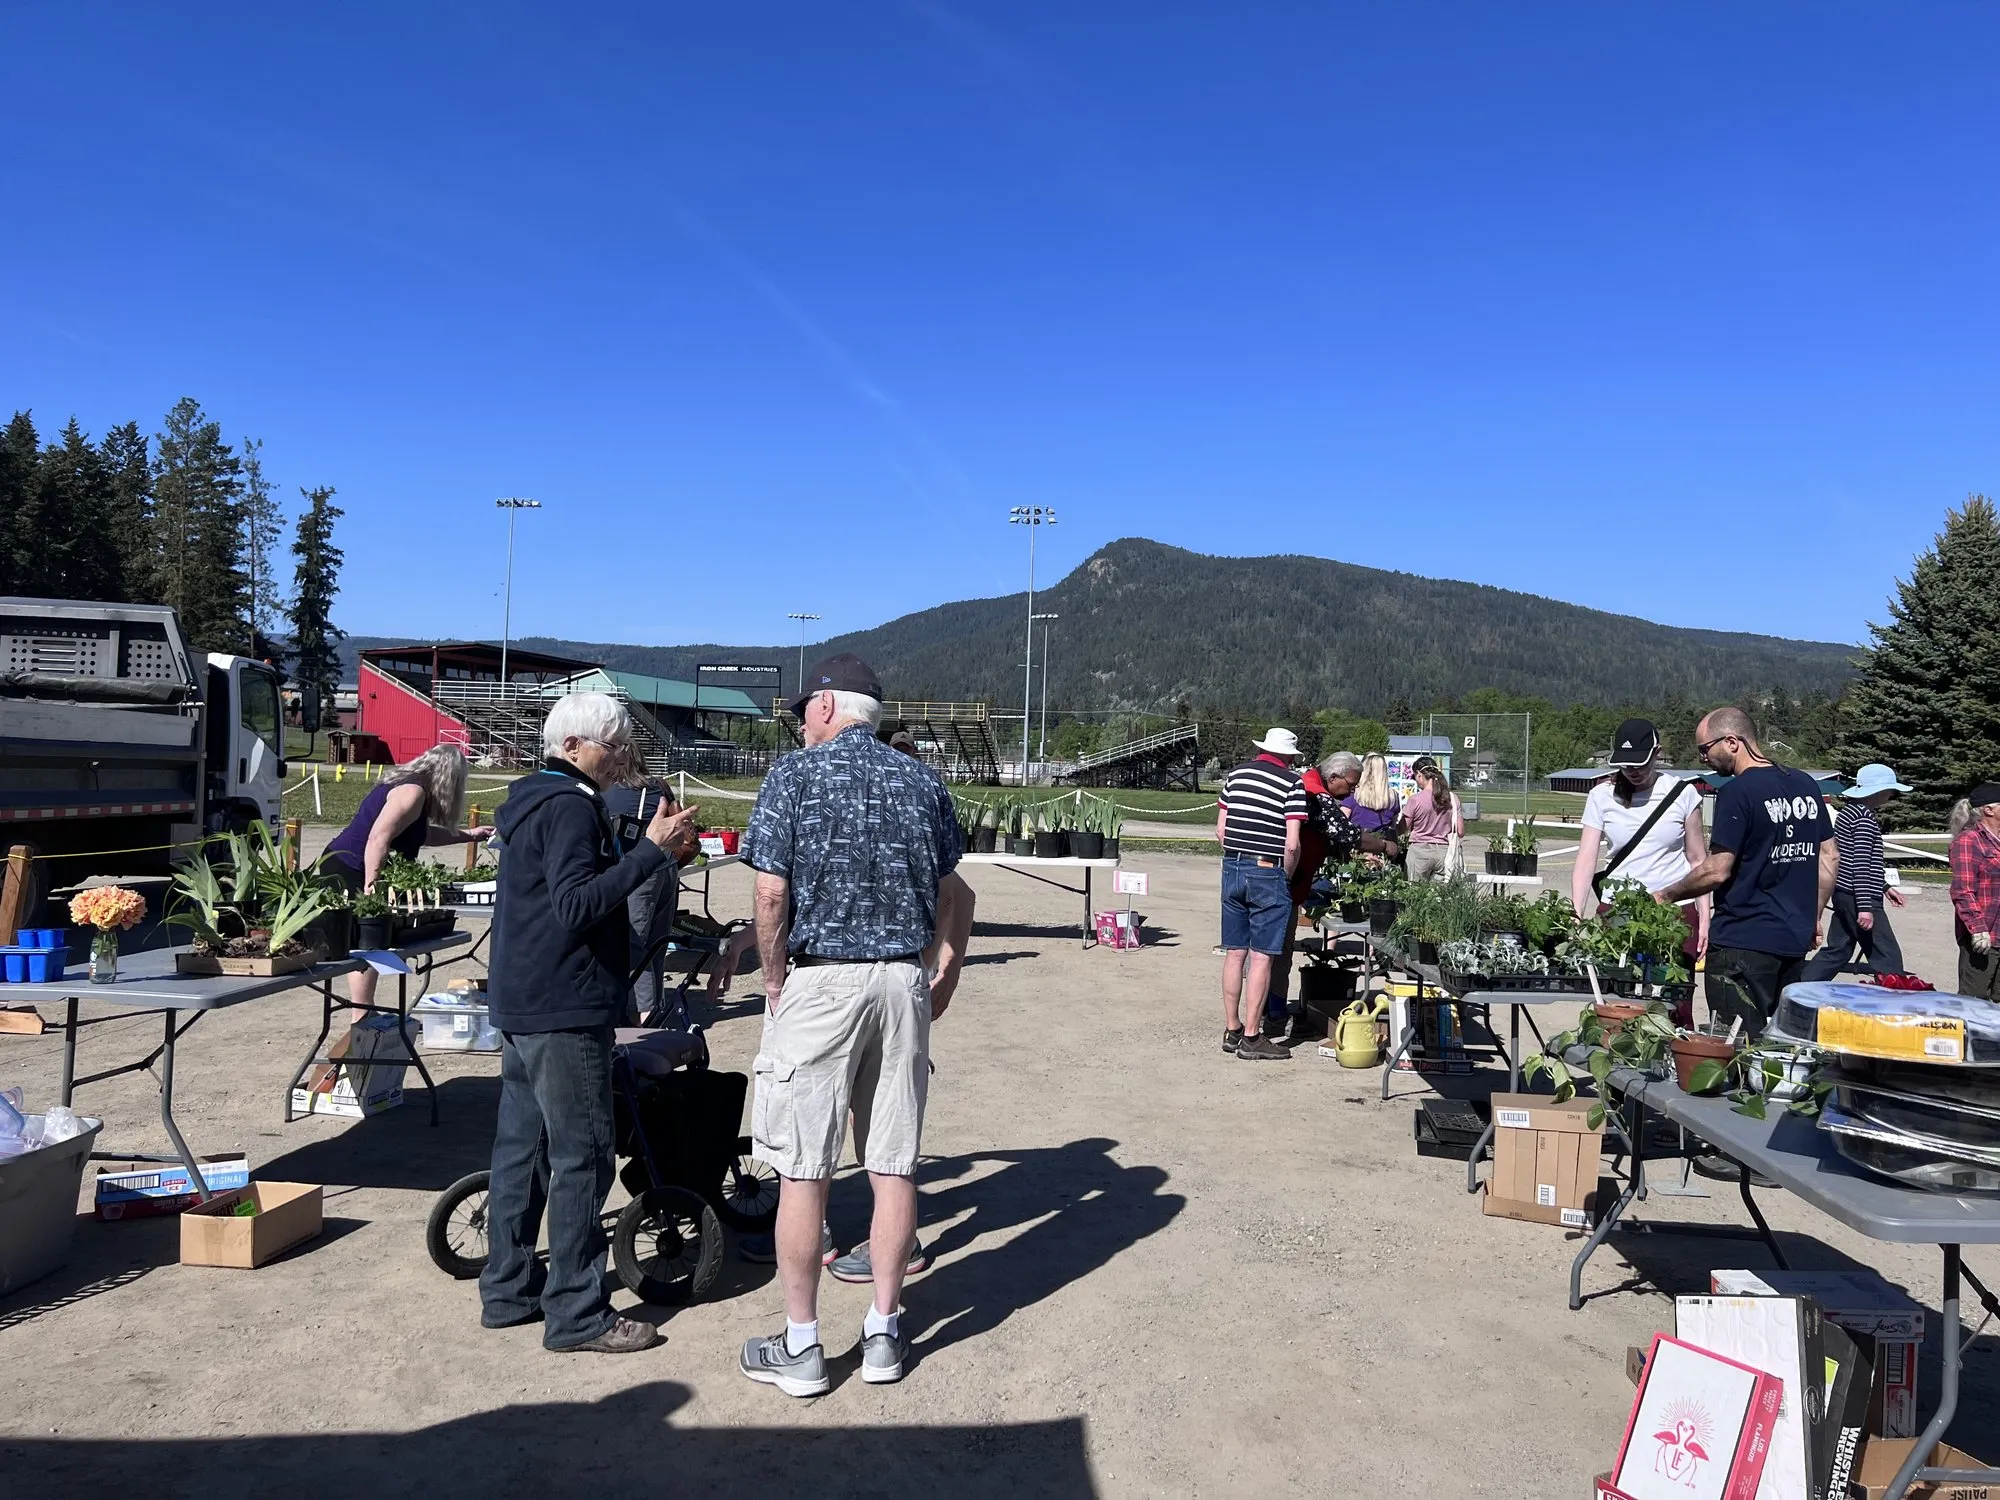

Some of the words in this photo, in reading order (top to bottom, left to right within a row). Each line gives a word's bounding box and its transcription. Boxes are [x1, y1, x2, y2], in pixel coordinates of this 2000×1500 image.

[1466, 738, 1473, 746] 2
[1747, 1422, 1763, 1463] FLAMINGOS
[1757, 1438, 1765, 1453] LOS
[1830, 1426, 1849, 1491] BREWING
